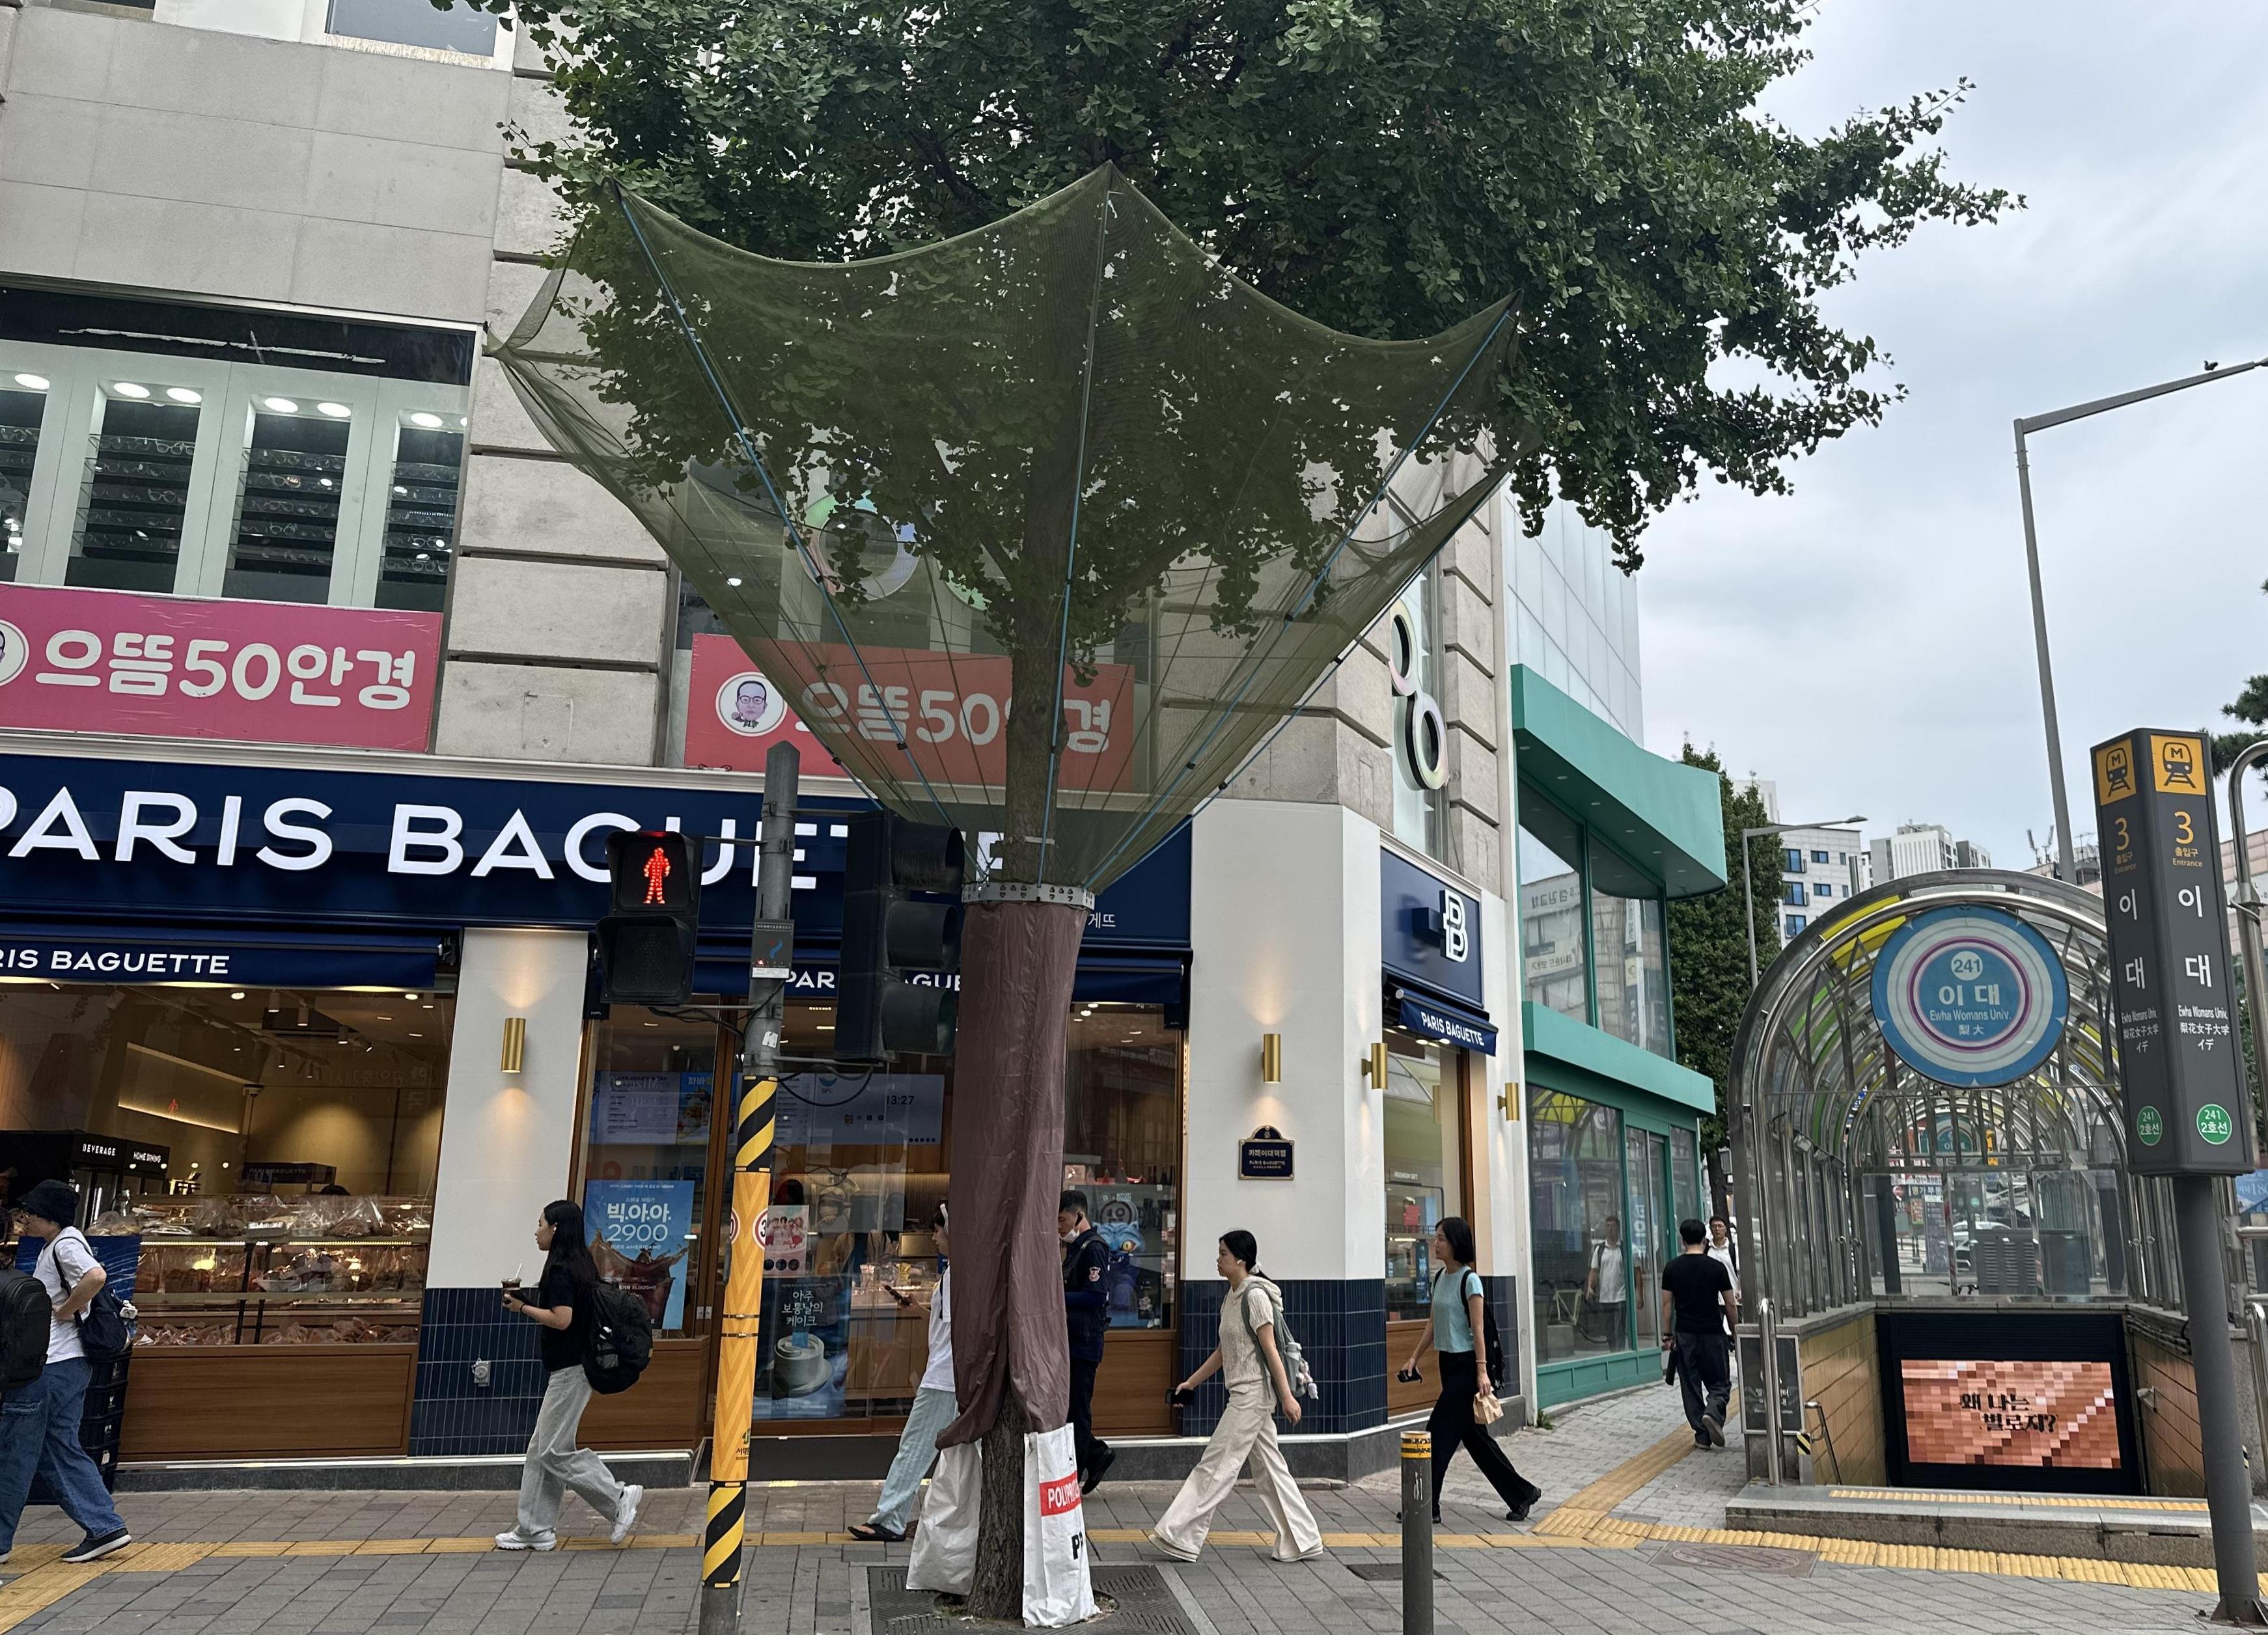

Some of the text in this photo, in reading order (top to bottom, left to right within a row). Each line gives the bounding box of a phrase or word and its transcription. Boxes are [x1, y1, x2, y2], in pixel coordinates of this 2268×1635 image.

[35, 630, 415, 709] 으뜸50안경
[795, 681, 1110, 754] 으뜸50경
[0, 786, 333, 870] ARIS
[2115, 817, 2129, 851] 3
[2174, 811, 2194, 844] 3
[2174, 847, 2198, 857] 출입구
[2172, 858, 2203, 868] Entrance
[1088, 913, 1116, 929] 게뜨
[0, 949, 230, 974] IS BAGUETTE
[1954, 959, 1980, 973] 241
[1929, 1009, 2012, 1021] Ewha Womans Univ.
[2178, 1004, 2228, 1019] Ewha Womans Univ.
[1421, 1011, 1485, 1047] PARIS BAGUETTE
[2198, 1039, 2214, 1051] イデ
[887, 1095, 914, 1105] 13:27
[2142, 1112, 2155, 1122] 241
[2205, 1109, 2221, 1120] 241
[2140, 1122, 2159, 1135] 2호선
[2201, 1121, 2228, 1134] 2호선
[82, 1144, 116, 1156] BEVERAGE
[607, 1203, 671, 1222] 빅.아.아.
[607, 1224, 668, 1241] 2900
[793, 1290, 814, 1302] 아주
[782, 1302, 823, 1315] 보통날의
[786, 1315, 817, 1327] 케이크
[1961, 1393, 2030, 1411] 왜 나는
